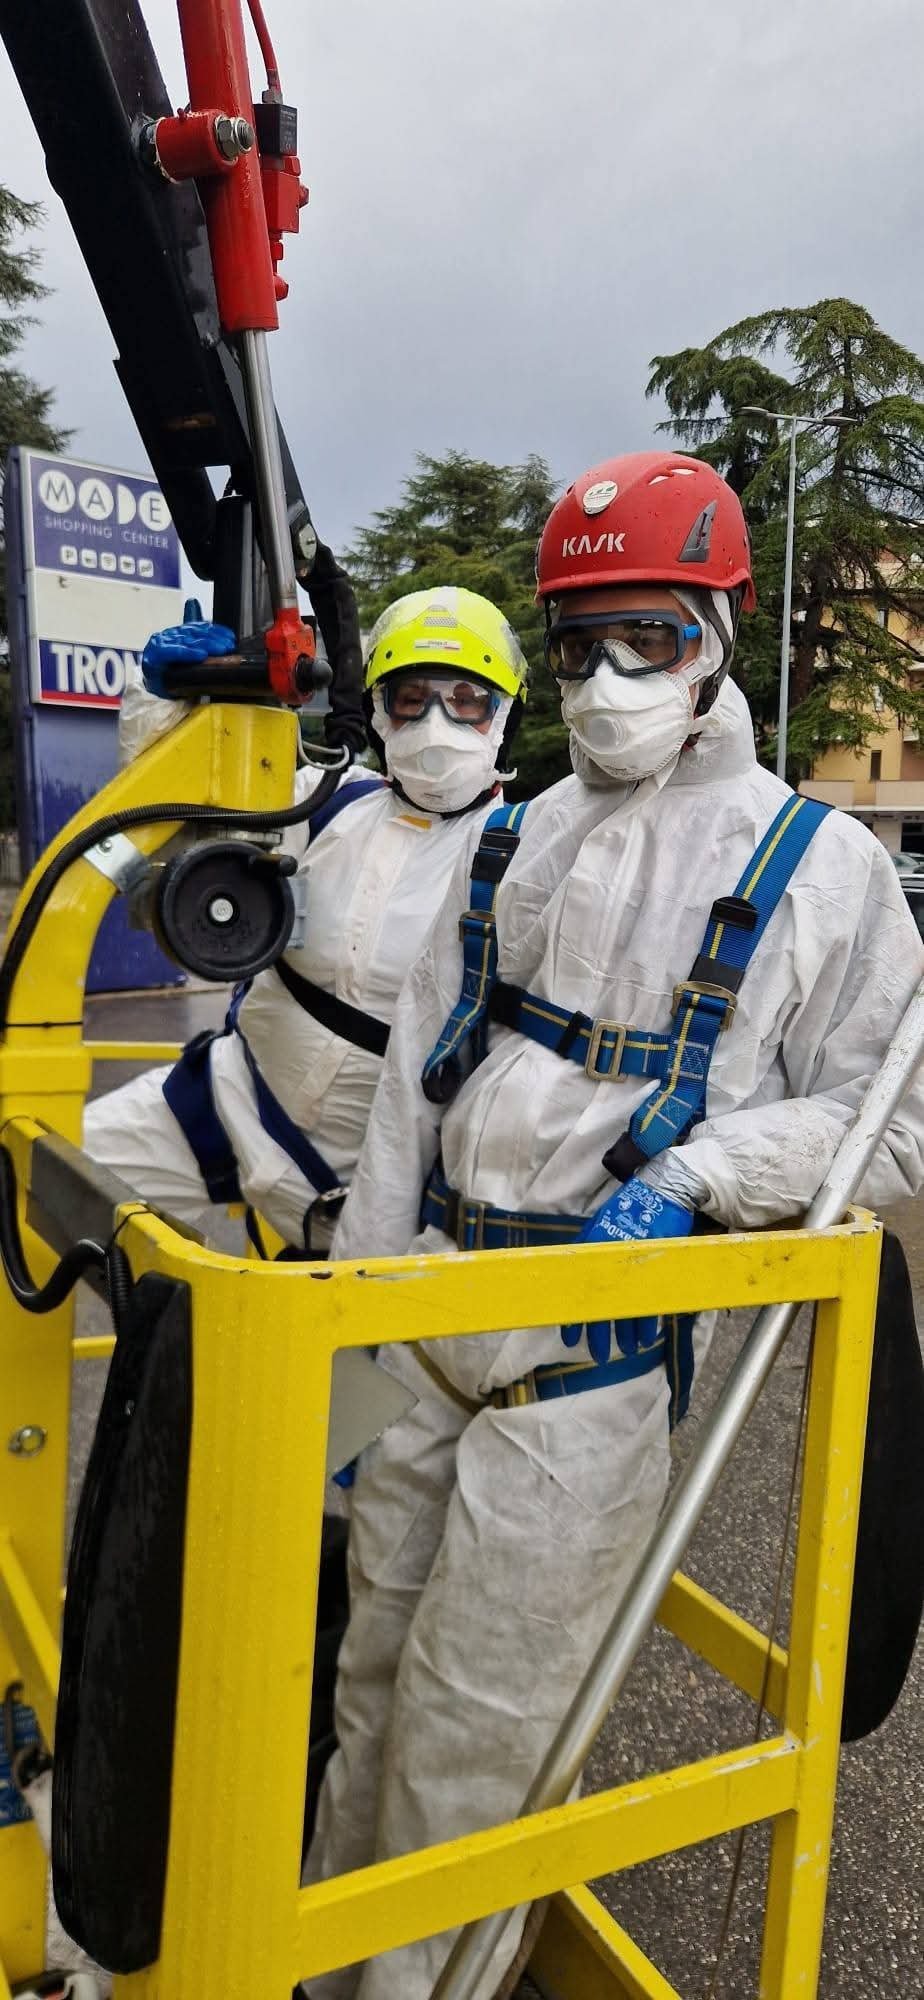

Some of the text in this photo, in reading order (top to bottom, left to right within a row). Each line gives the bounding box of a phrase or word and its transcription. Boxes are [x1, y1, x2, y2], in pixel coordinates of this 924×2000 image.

[40, 470, 171, 531] MADE
[45, 516, 168, 549] SHOPPING CENTER
[562, 532, 626, 558] KASK
[600, 1217, 637, 1240] axiDex
